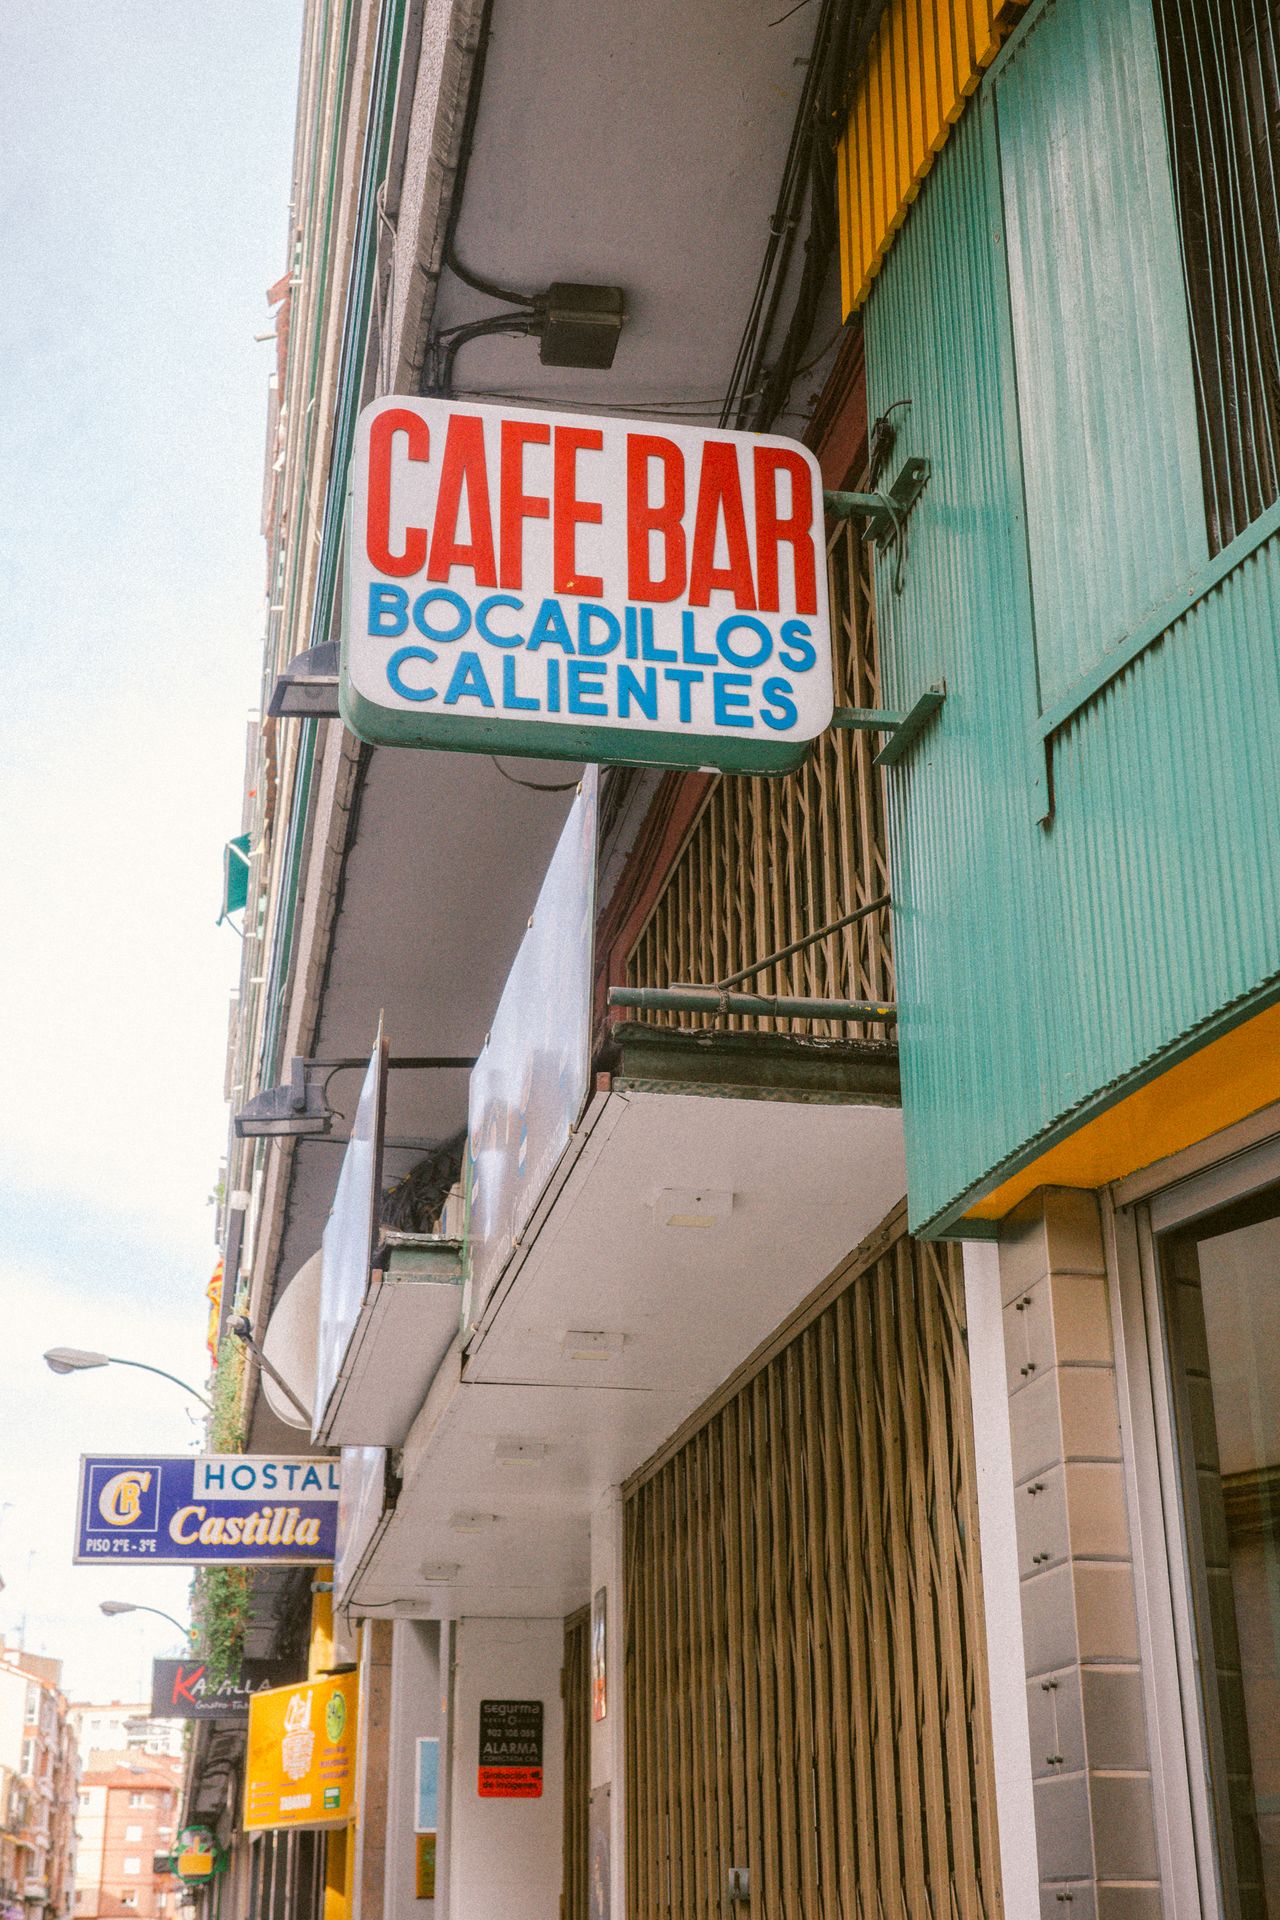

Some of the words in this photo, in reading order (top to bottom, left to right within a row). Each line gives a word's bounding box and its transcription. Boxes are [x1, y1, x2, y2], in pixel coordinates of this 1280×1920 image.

[366, 408, 603, 598] CAFE
[627, 433, 817, 615] BAR
[367, 581, 817, 672] BOCADILLOS
[386, 646, 798, 731] CALIENTES
[204, 1464, 340, 1491] HOSTAL
[169, 1506, 321, 1545] Castilla
[85, 1538, 111, 1552] PISO
[484, 1704, 540, 1716] segurma
[483, 1742, 539, 1755] ALARMA
